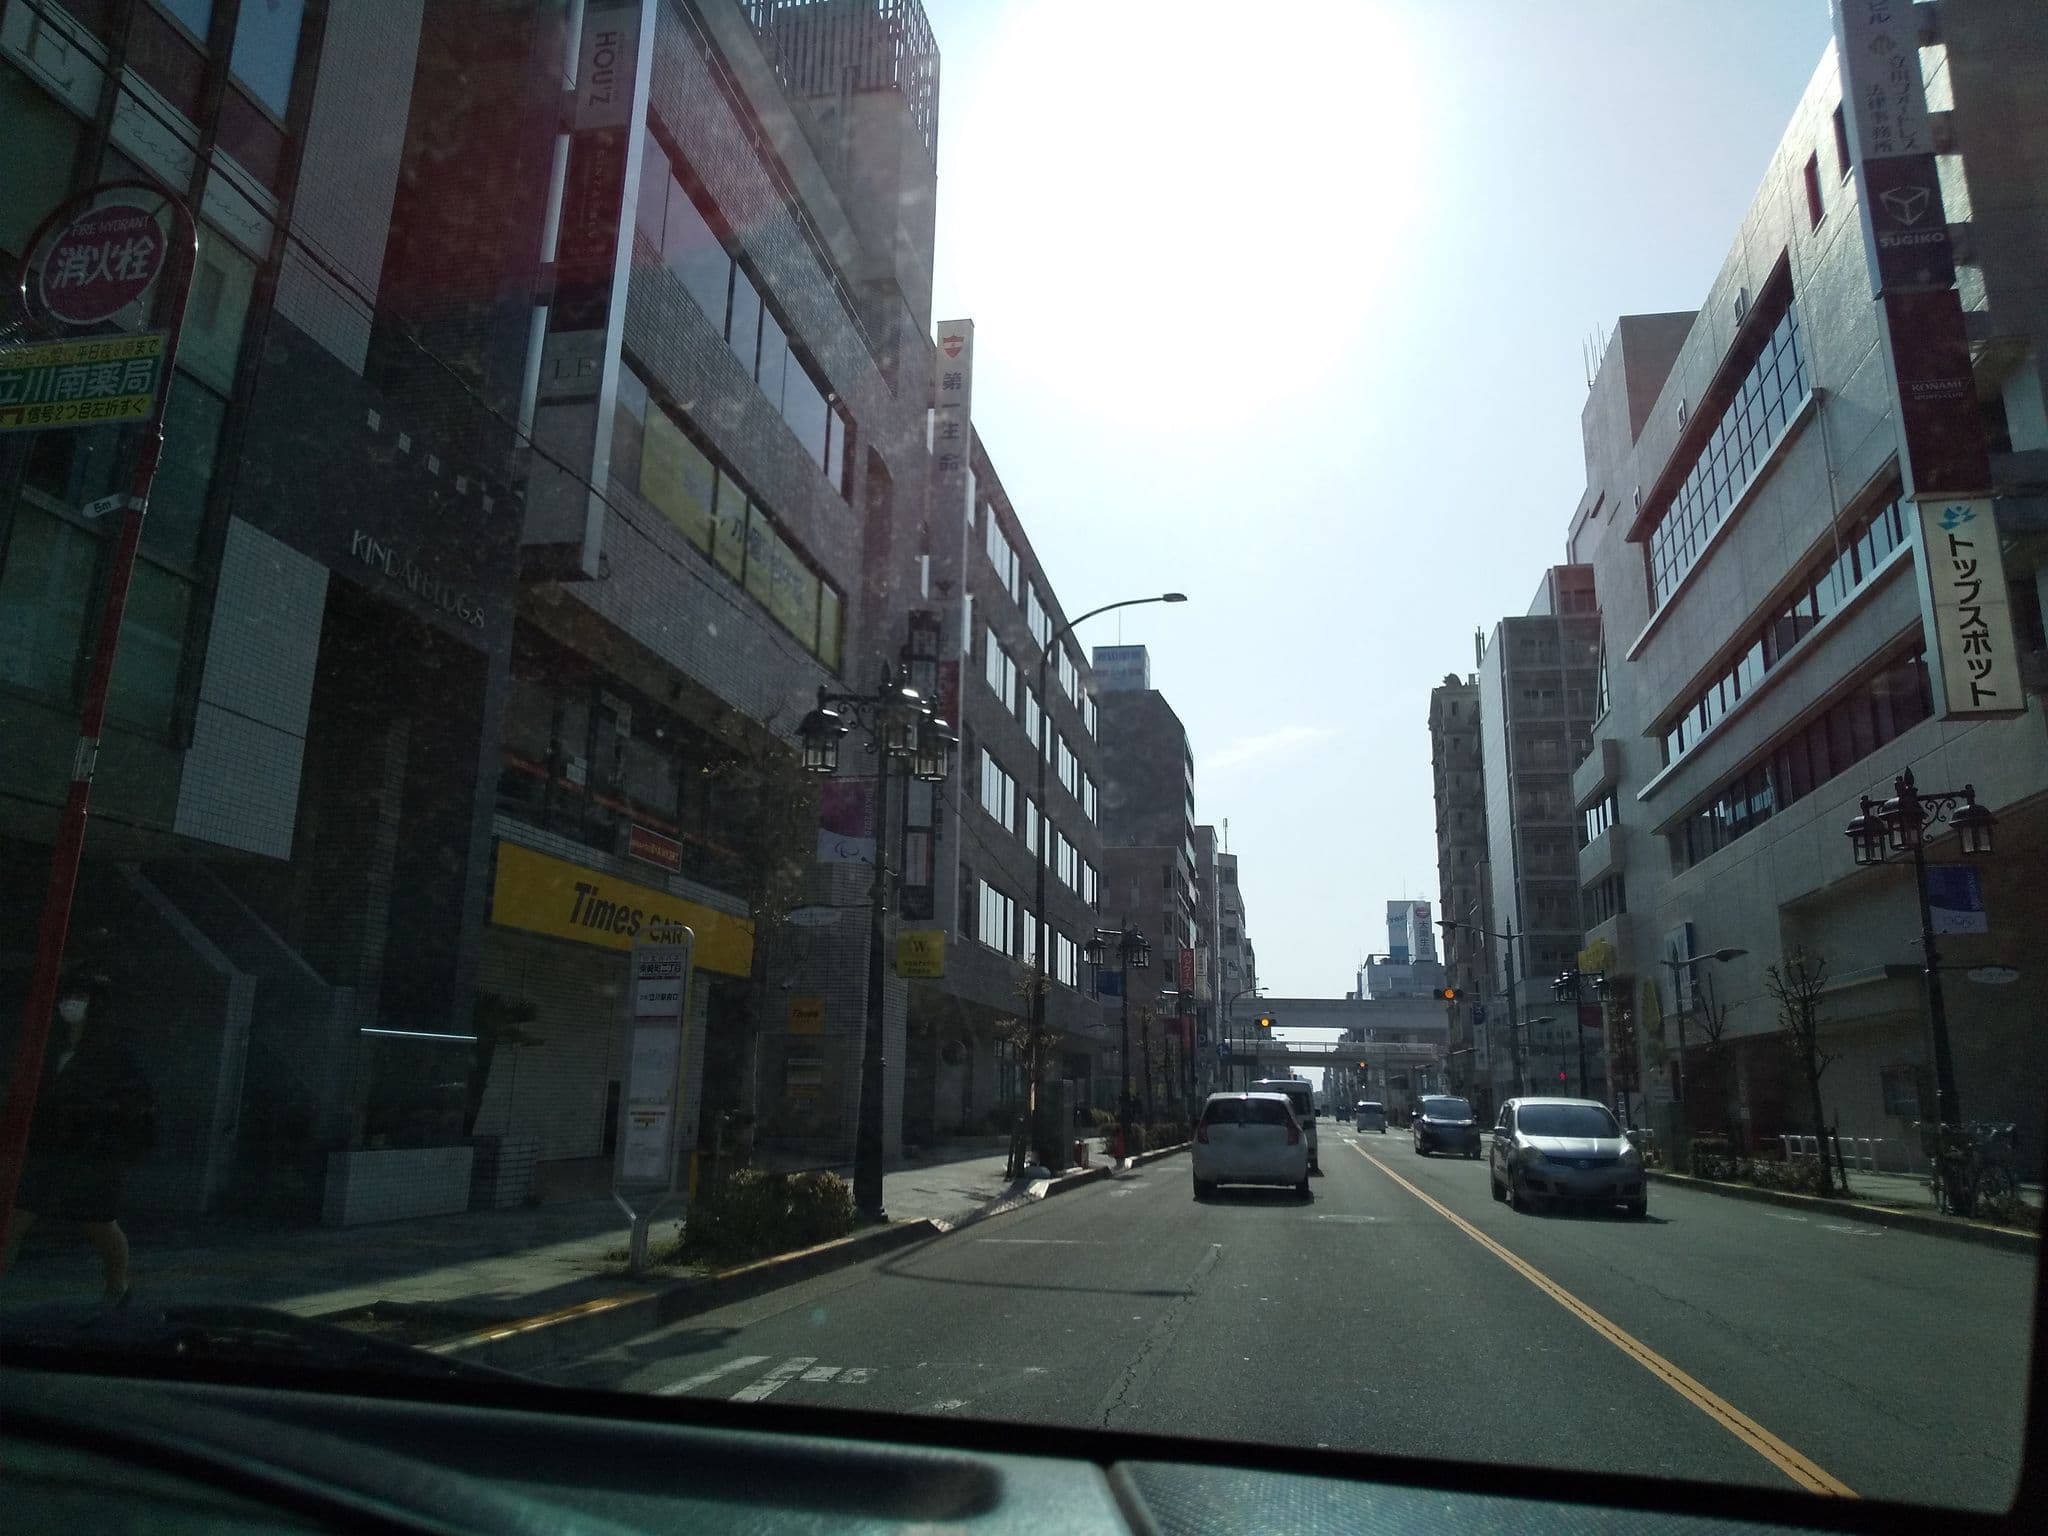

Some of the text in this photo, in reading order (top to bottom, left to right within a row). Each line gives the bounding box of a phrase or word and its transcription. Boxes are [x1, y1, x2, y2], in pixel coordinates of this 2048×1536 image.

[71, 214, 151, 237] FIRE HYDRANT
[1880, 232, 1945, 248] SUGIKO
[51, 235, 156, 290] 消火栓
[0, 358, 154, 405] 立川南薬局
[1911, 380, 1963, 394] KONAMI
[940, 371, 963, 472] 第一生命
[1949, 533, 1997, 707] トップスポット
[570, 882, 644, 937] Times
